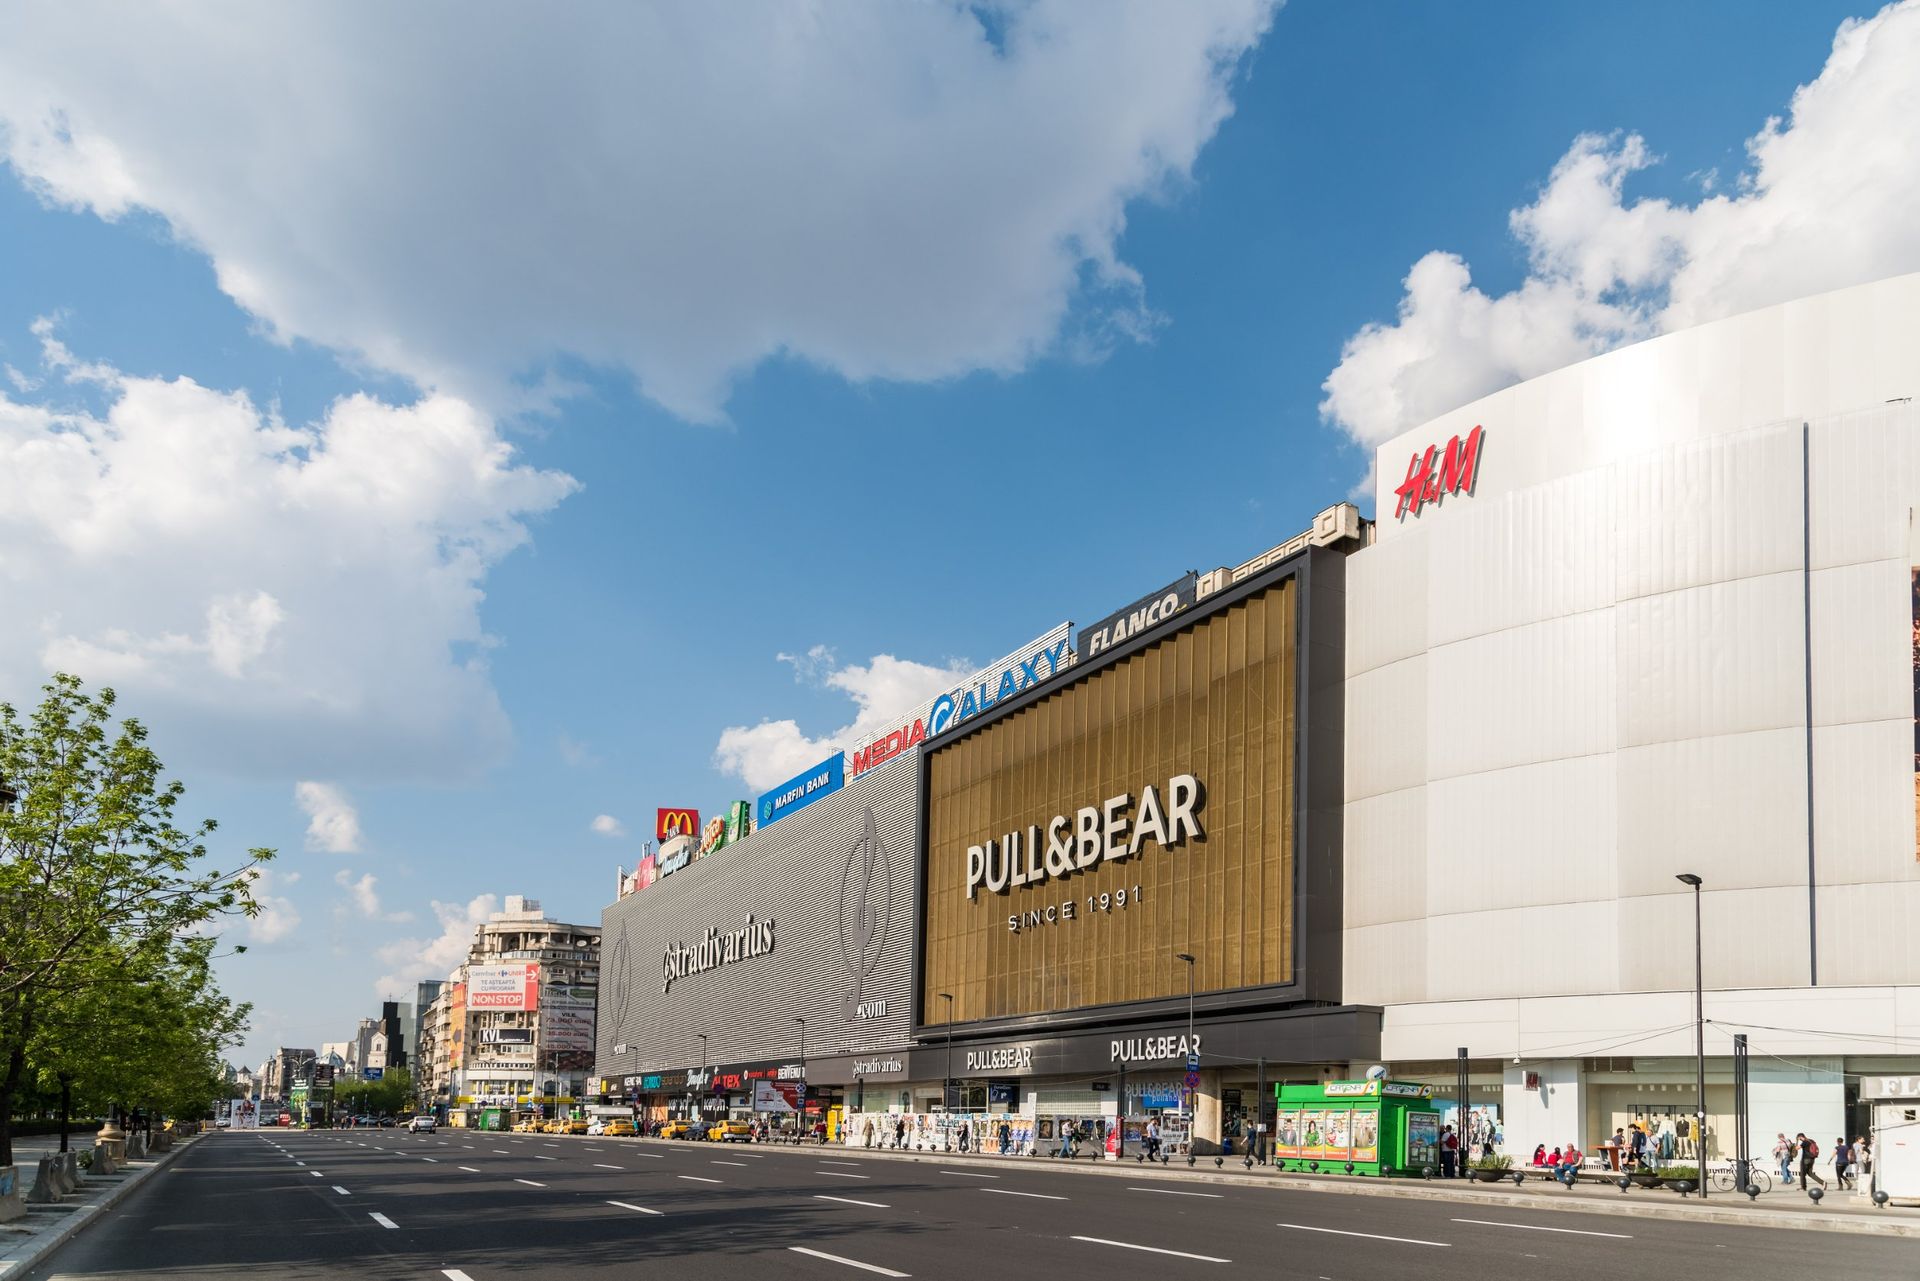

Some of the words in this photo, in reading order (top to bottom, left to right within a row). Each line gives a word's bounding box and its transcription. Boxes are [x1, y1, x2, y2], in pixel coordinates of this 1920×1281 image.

[1394, 425, 1483, 519] H&M
[1090, 593, 1179, 656] FLANCO
[853, 718, 926, 776] MEDIA
[775, 784, 805, 810] MARFIN
[807, 772, 830, 794] BANK
[967, 774, 1201, 900] PULL&BEAR
[1008, 901, 1075, 931] SINCE
[1087, 885, 1142, 913] 1991
[967, 1048, 1032, 1070] PULL&BEAR
[1111, 1034, 1201, 1062] PULL&BEAR
